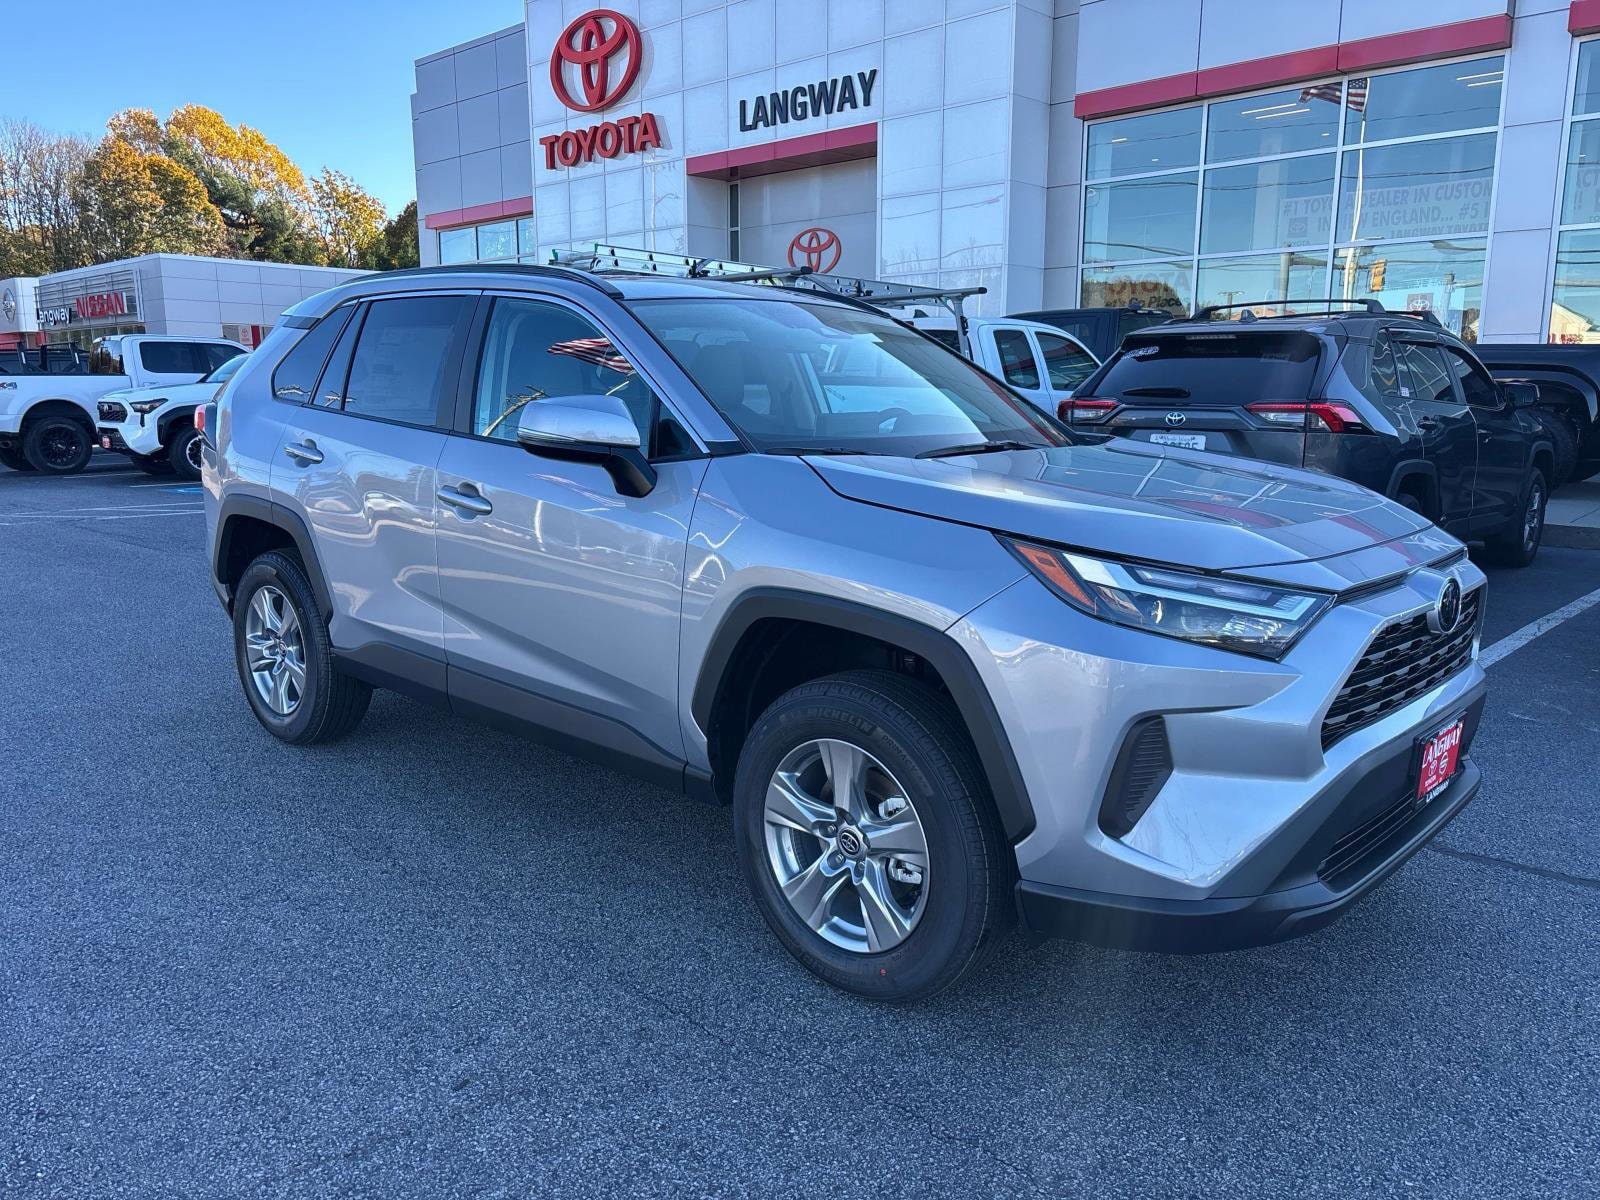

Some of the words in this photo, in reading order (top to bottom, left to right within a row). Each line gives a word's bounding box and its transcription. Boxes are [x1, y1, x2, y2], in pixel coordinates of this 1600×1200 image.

[739, 69, 877, 132] LANGWAY
[540, 112, 663, 170] TOYOTA
[1434, 180, 1494, 202] CUSTOM
[75, 291, 127, 318] NISSAN
[1422, 726, 1461, 769] LANGWAY
